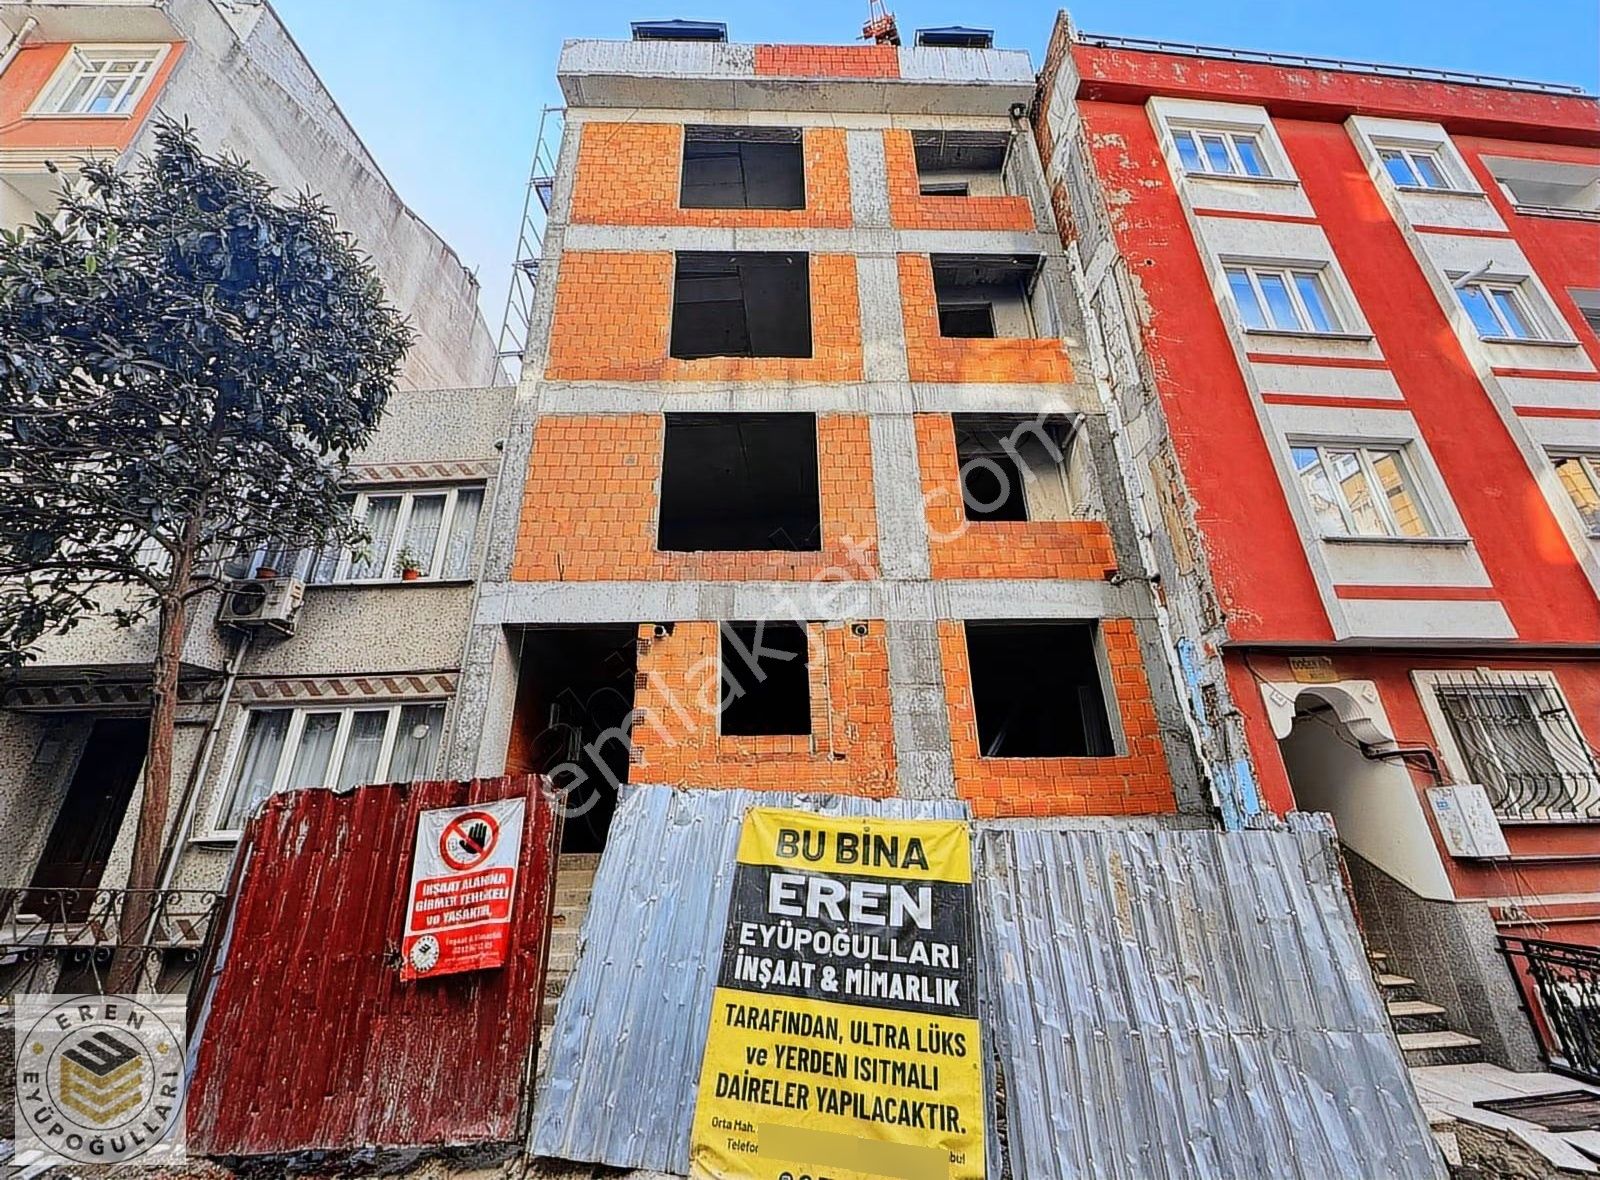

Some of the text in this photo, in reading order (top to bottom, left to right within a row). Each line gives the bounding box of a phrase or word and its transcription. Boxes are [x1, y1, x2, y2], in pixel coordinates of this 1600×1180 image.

[776, 827, 929, 870] BU BİNA
[768, 873, 932, 930] EREN
[739, 920, 959, 969] EYÜPOĞULLARI
[734, 948, 960, 1007] İNŞAAT & MİMARLIK
[725, 1004, 966, 1057] TARAFINDAN, ULTRA LÜKS
[746, 1044, 938, 1091] ve YERDEN ISITMALI
[711, 1116, 732, 1131] Orta
[734, 1119, 756, 1133] Mah.
[715, 1070, 966, 1134] DAİRELER YAPILACAKTIR.
